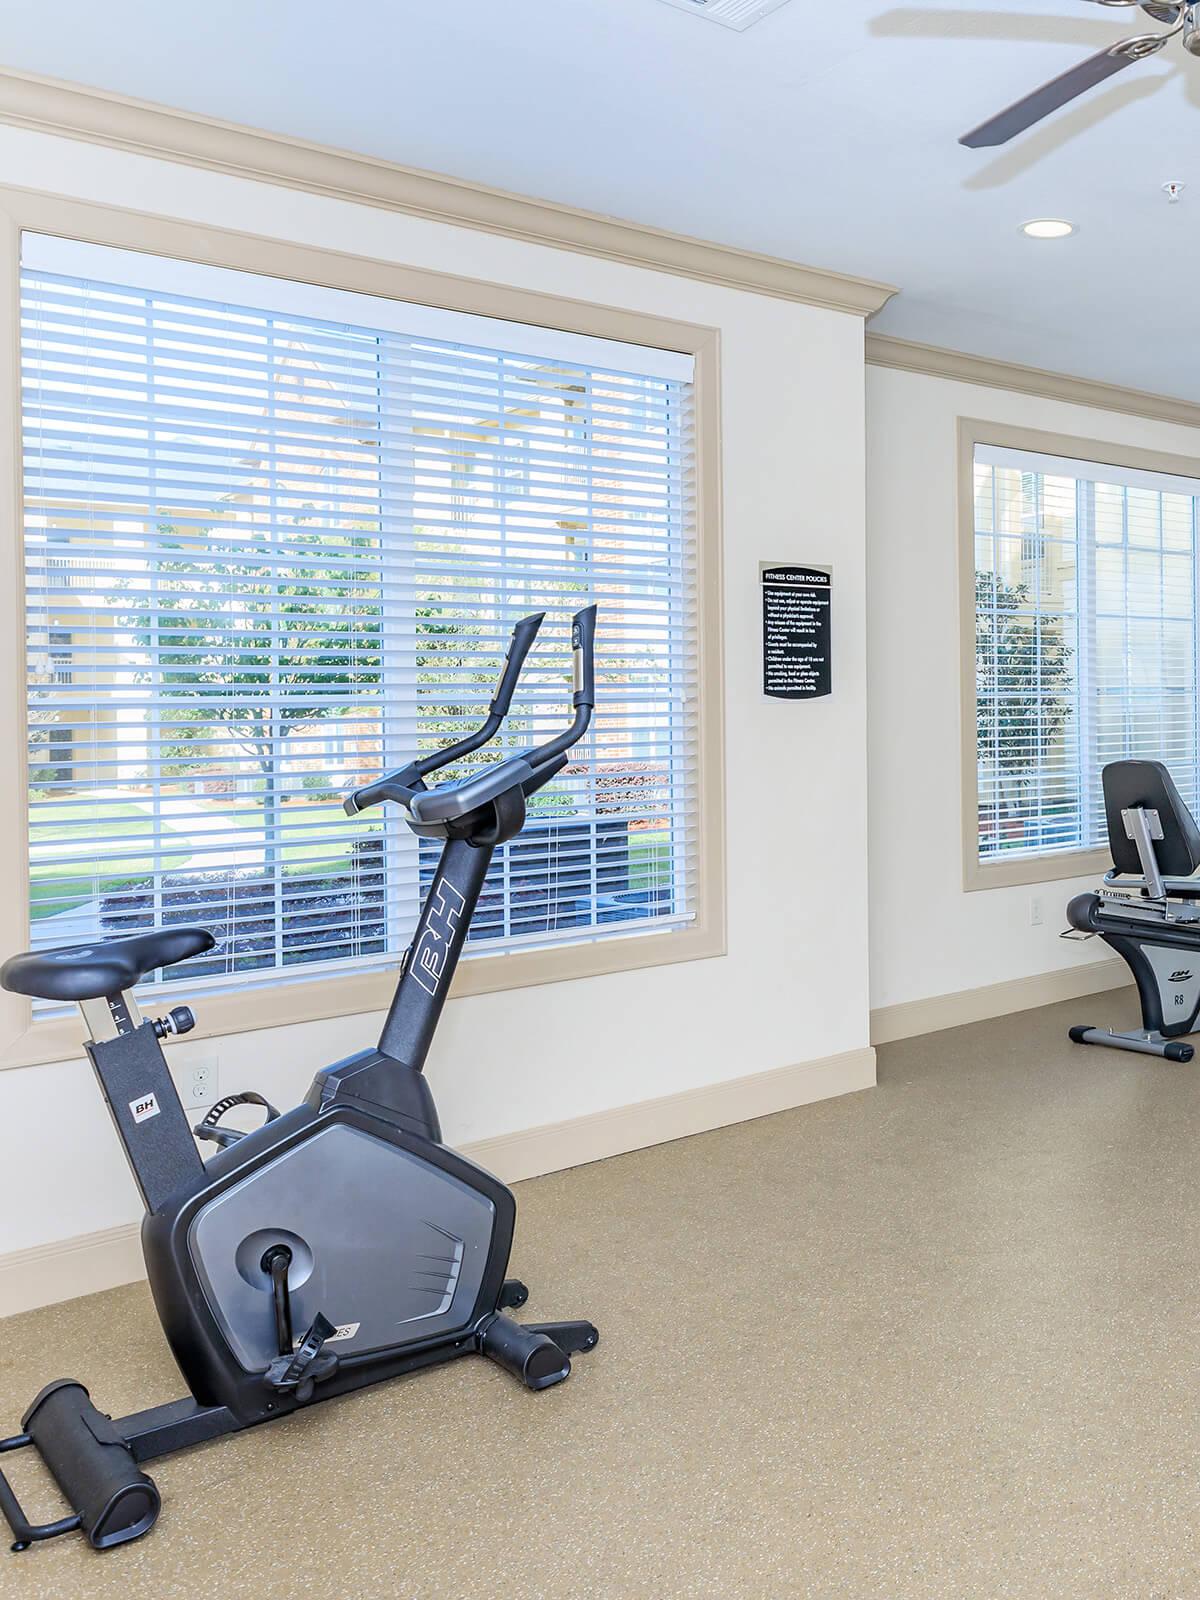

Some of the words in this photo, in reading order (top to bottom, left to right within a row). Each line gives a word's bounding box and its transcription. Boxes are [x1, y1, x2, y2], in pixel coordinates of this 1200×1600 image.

[410, 877, 466, 996] BH
[1174, 994, 1184, 1006] R8
[136, 1099, 154, 1114] BH
